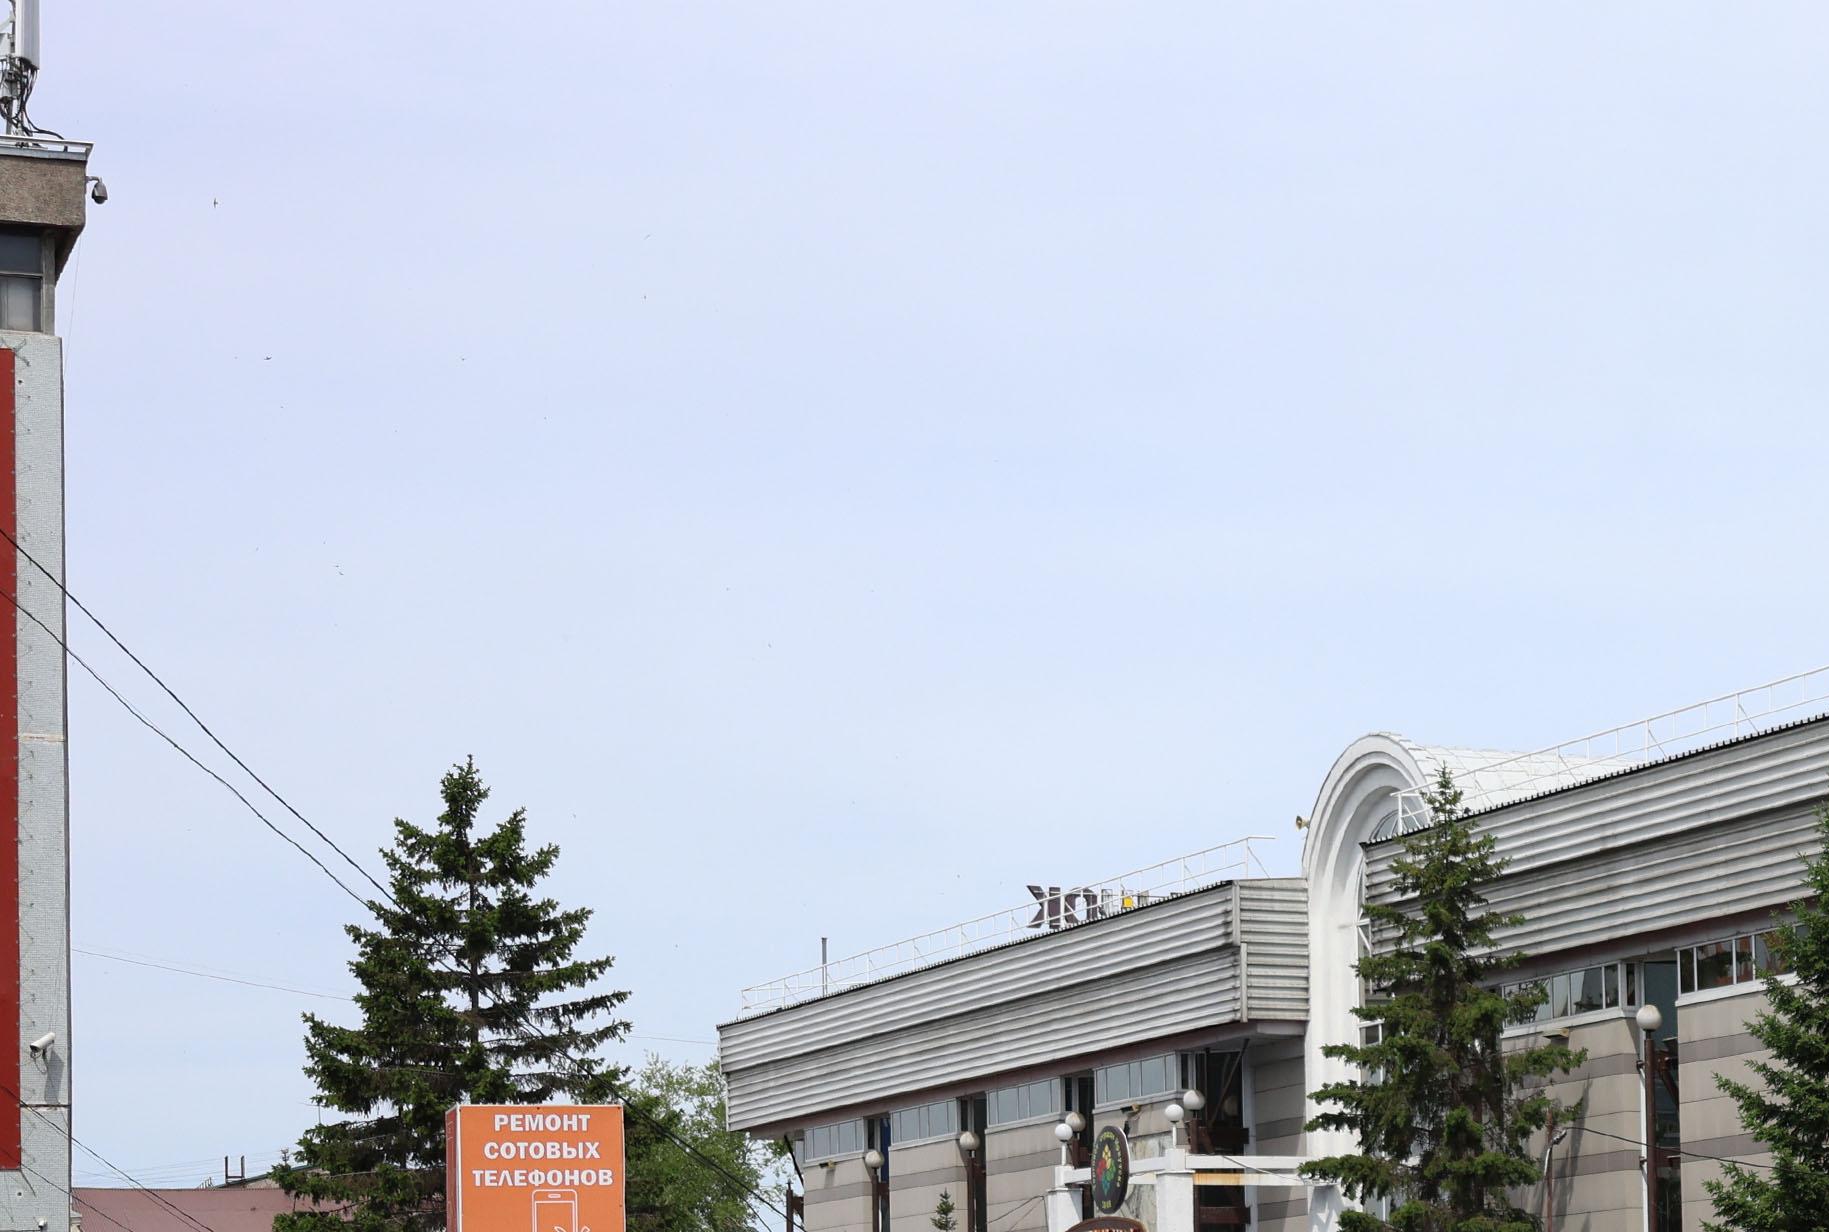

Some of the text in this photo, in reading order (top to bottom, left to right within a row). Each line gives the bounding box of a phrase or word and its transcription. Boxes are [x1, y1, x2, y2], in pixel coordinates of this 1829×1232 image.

[494, 1114, 591, 1132] РЕМОНТ
[483, 1142, 601, 1159] СОТОВЫХ
[472, 1169, 613, 1187] ТЕЛЕФОНОВ
